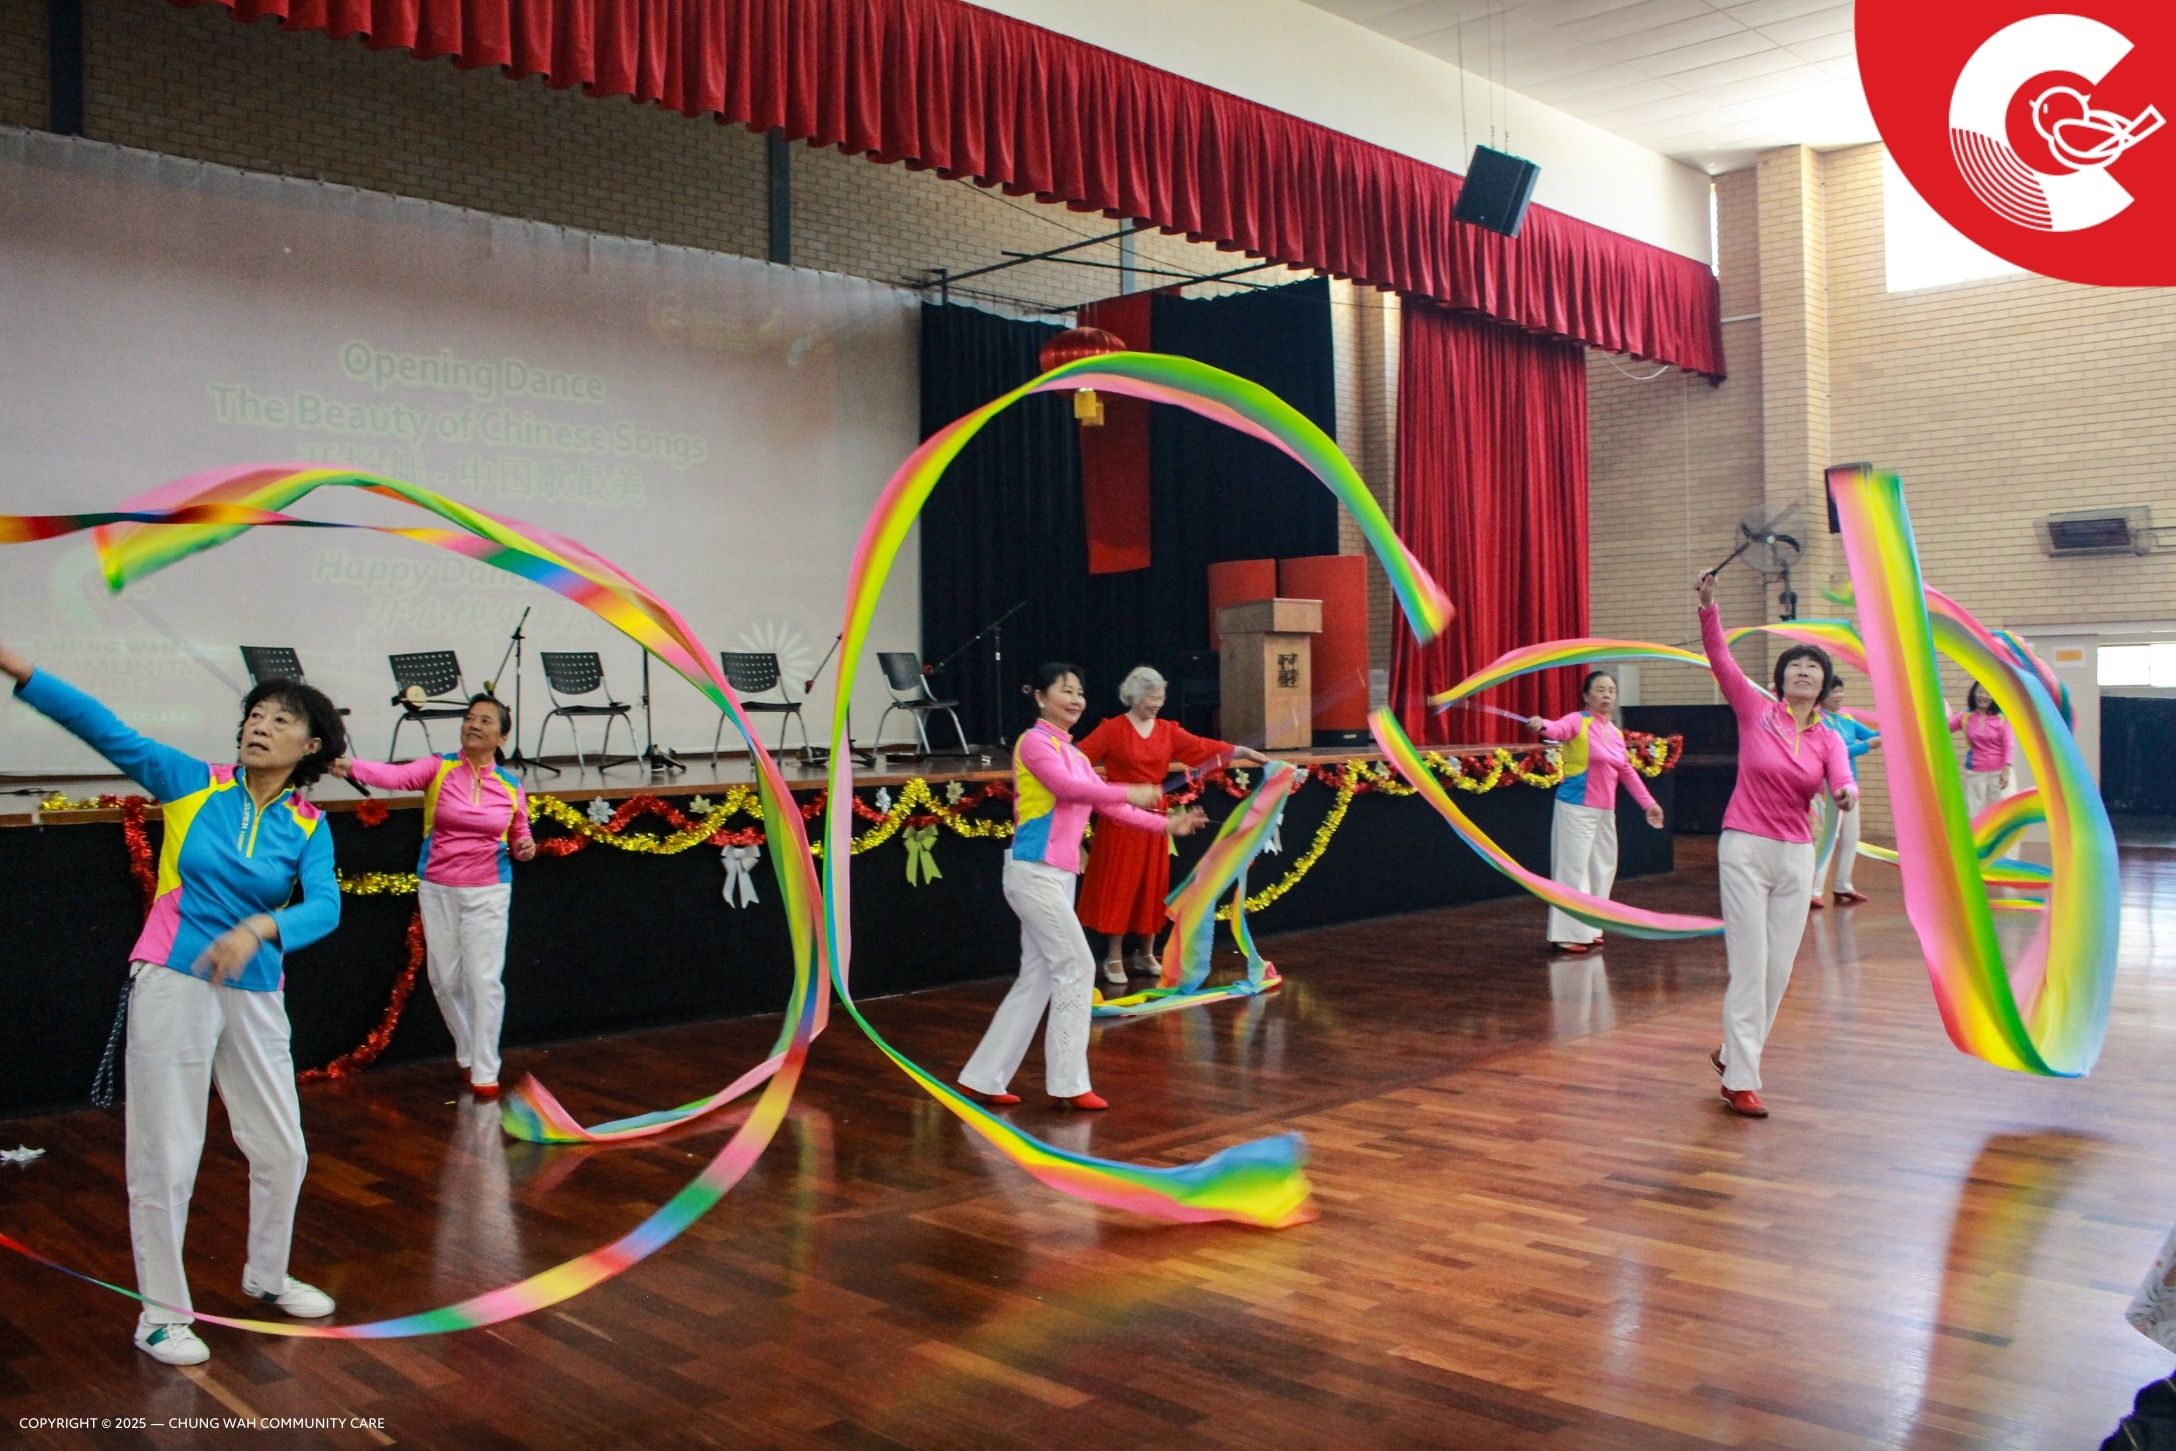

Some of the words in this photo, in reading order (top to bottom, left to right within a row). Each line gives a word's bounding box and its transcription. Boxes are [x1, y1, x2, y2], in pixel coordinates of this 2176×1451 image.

[341, 342, 493, 398] Opening
[505, 360, 604, 400] Dance
[209, 384, 285, 424] The
[298, 394, 426, 442] Beauty
[438, 409, 475, 438] of
[481, 412, 606, 450] Chinese
[614, 425, 705, 466] Songs
[314, 550, 431, 592] Happy
